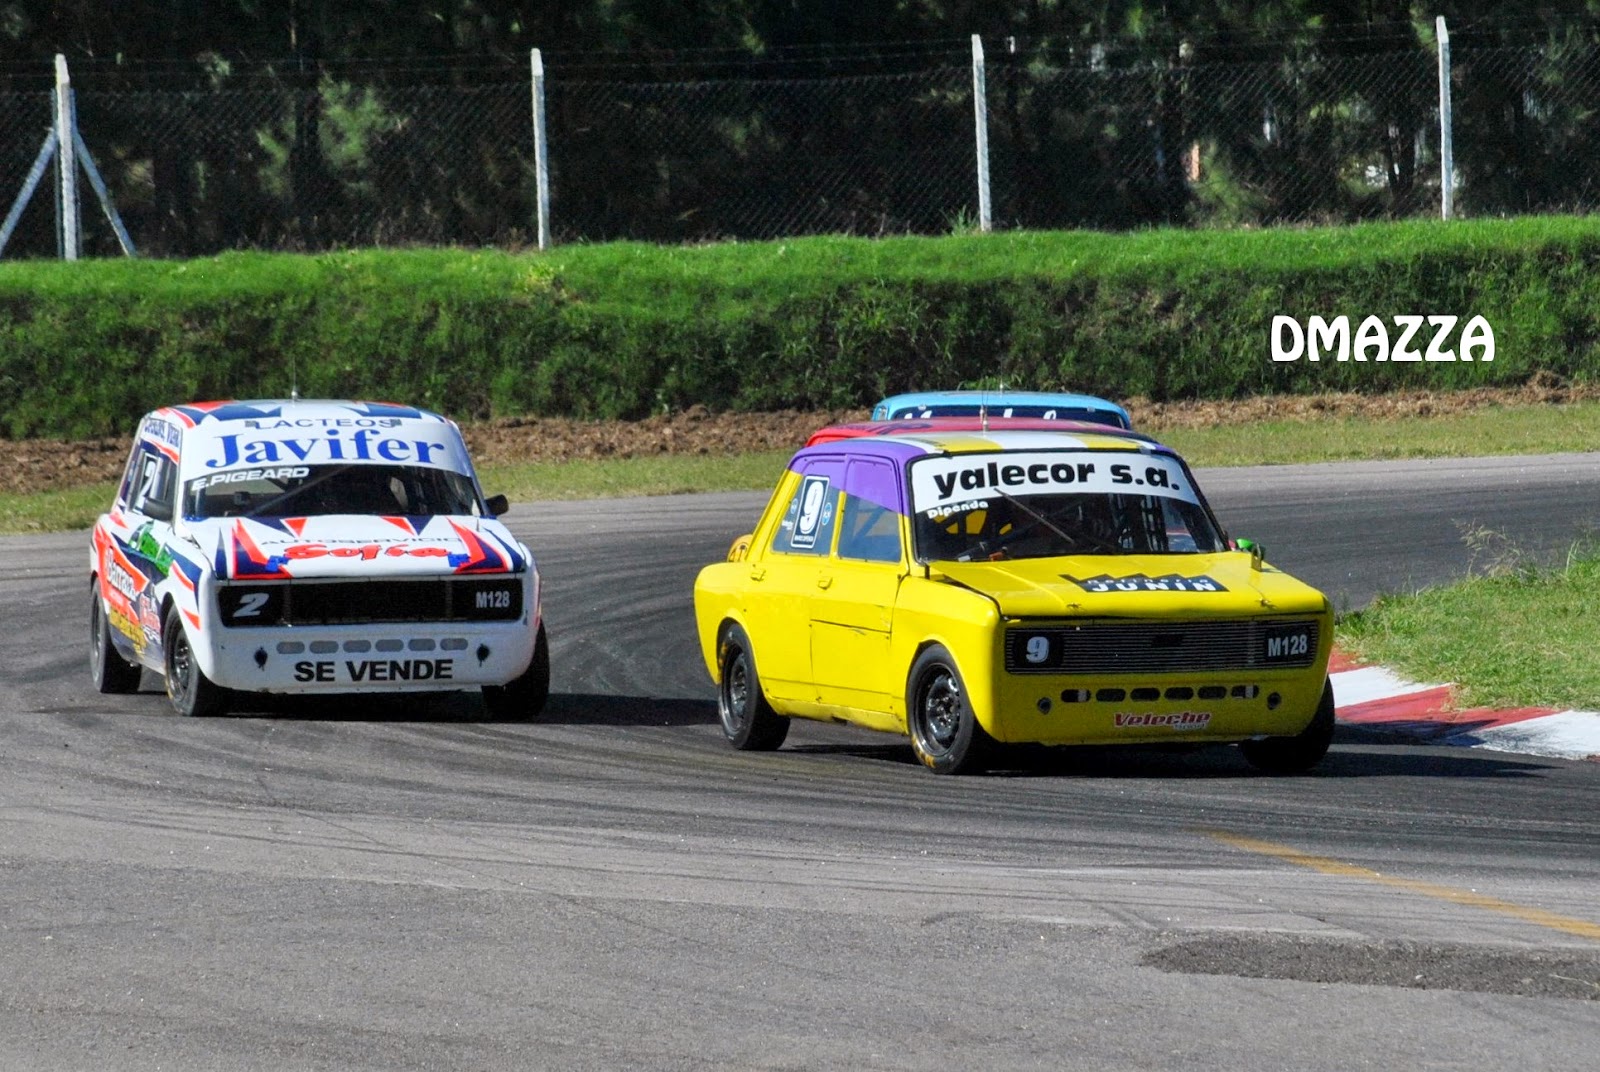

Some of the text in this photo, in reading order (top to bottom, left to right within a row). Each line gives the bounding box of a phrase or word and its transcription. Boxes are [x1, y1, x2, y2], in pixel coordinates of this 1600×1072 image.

[255, 418, 396, 430] LACTEOS
[205, 428, 446, 469] Javifer
[190, 466, 311, 492] E.PIGEARD
[933, 461, 1181, 500] yalecor s.a.
[799, 481, 824, 534] 9
[926, 499, 990, 519] Dipenda
[232, 592, 270, 618] 2
[475, 591, 511, 609] M128
[1026, 635, 1051, 664] 9
[1267, 633, 1308, 658] M128
[294, 659, 454, 683] SE VENDE
